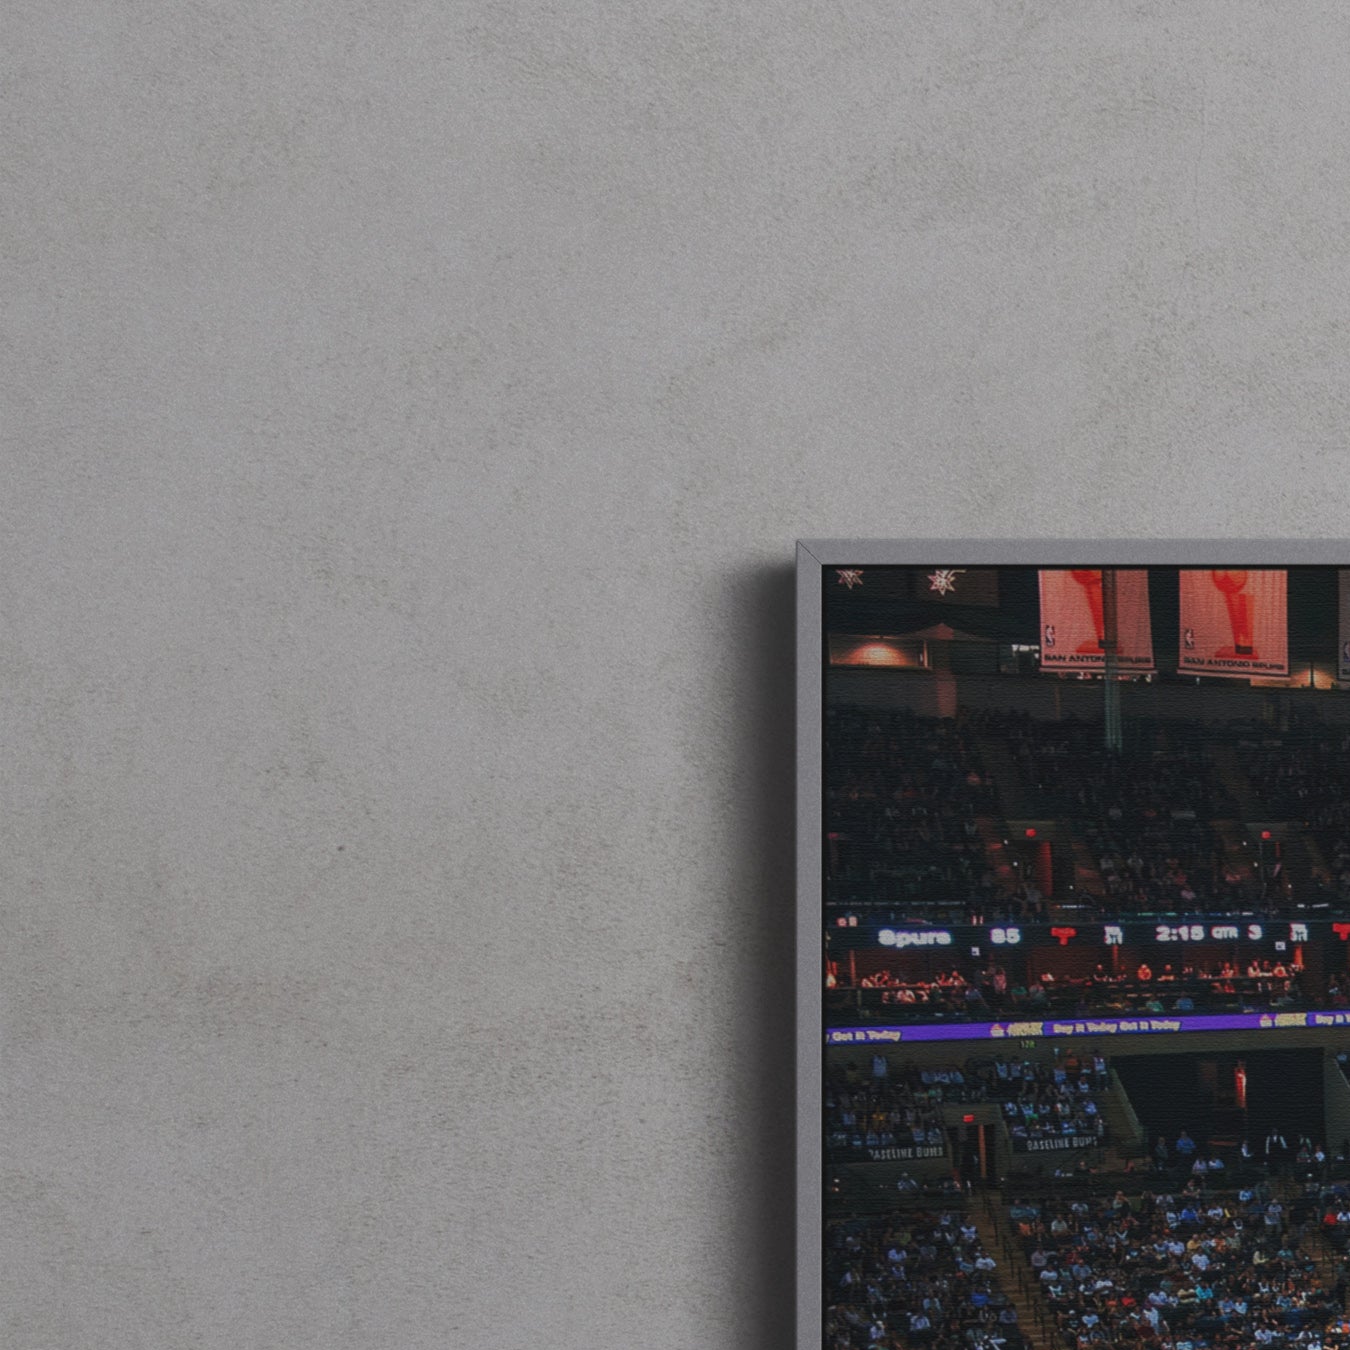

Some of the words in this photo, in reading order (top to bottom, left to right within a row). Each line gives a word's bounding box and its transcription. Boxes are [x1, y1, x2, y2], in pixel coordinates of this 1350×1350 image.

[879, 929, 953, 947] Spurs
[991, 928, 1021, 944] 85
[1155, 926, 1204, 941] 2:15
[867, 1030, 901, 1042] Today
